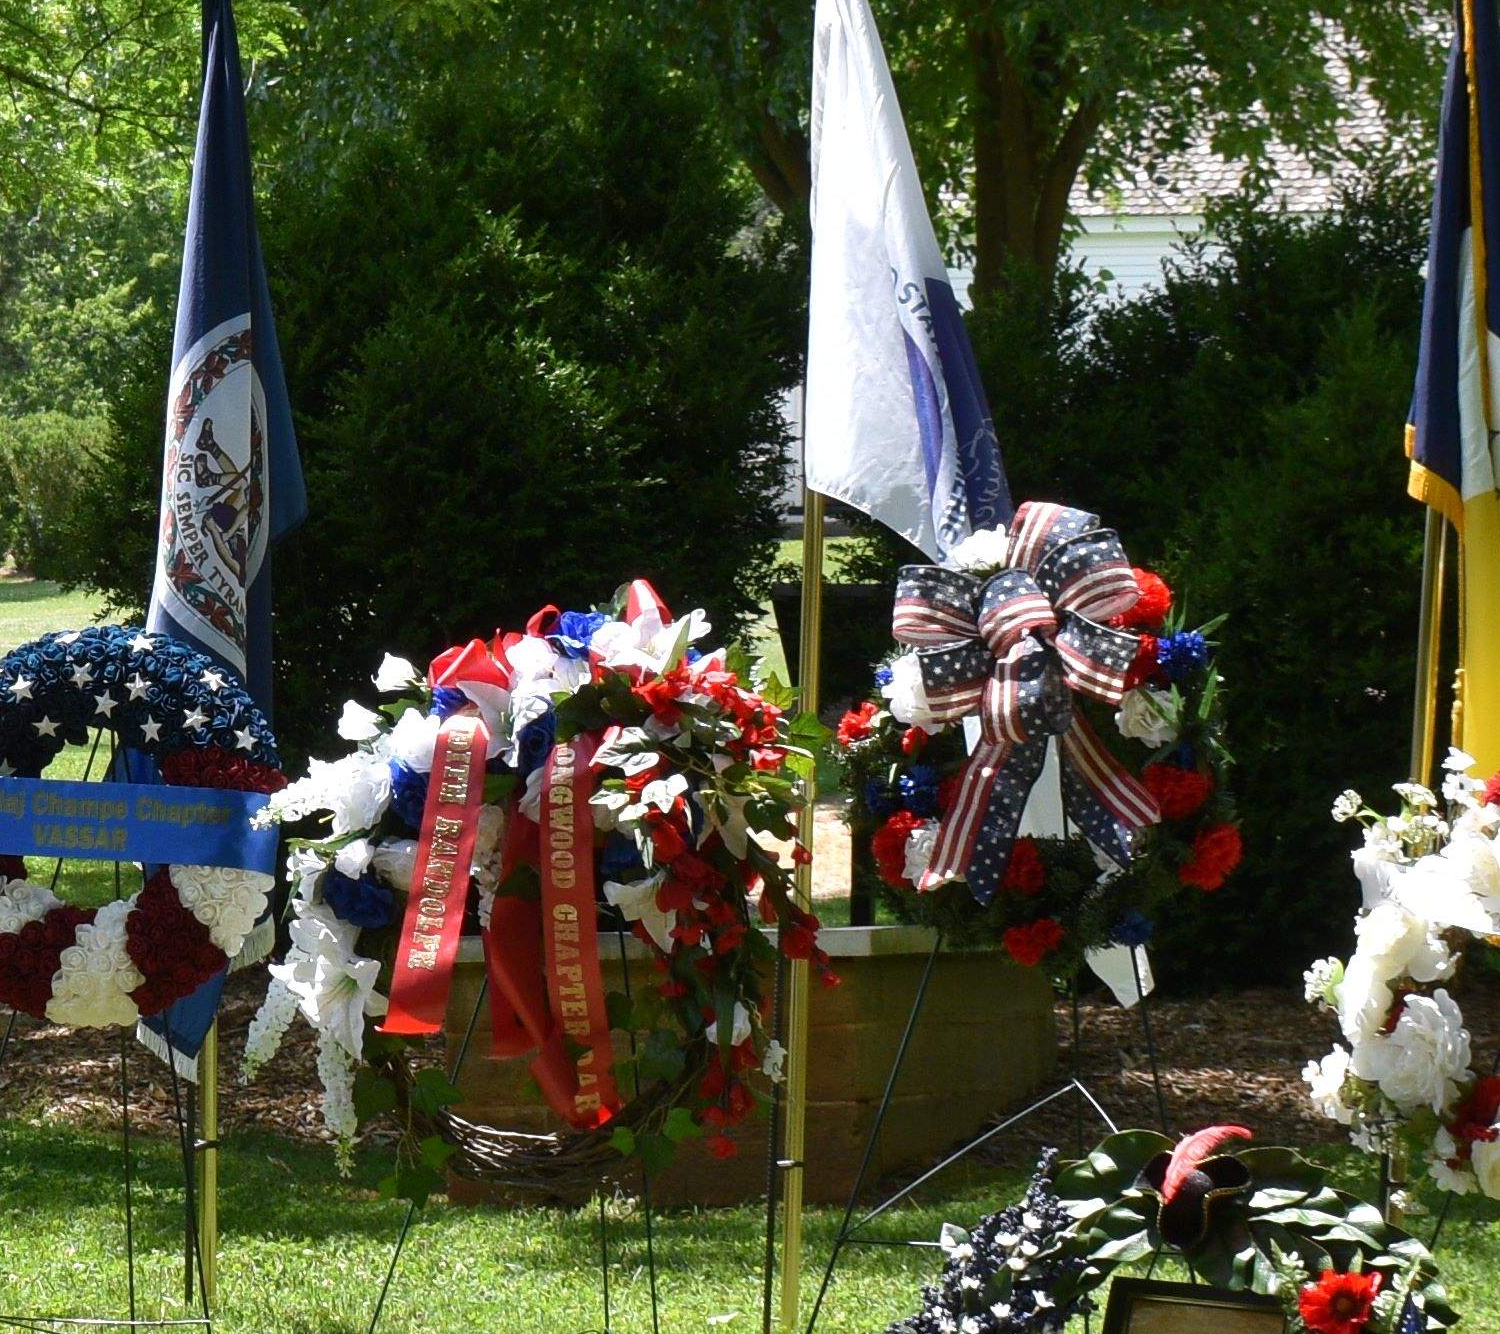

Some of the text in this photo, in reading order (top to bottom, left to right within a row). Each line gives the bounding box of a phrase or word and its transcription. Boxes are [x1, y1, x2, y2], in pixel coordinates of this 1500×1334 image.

[176, 452, 195, 484] SIC
[176, 491, 210, 567] SEMPER
[33, 791, 129, 821] Champe
[136, 796, 232, 827] Chapter
[33, 823, 128, 852] VASSAR
[549, 743, 576, 889] ONGWOOD
[407, 730, 473, 970] DITH RANDOLPH
[552, 904, 590, 1036] CHAPTER
